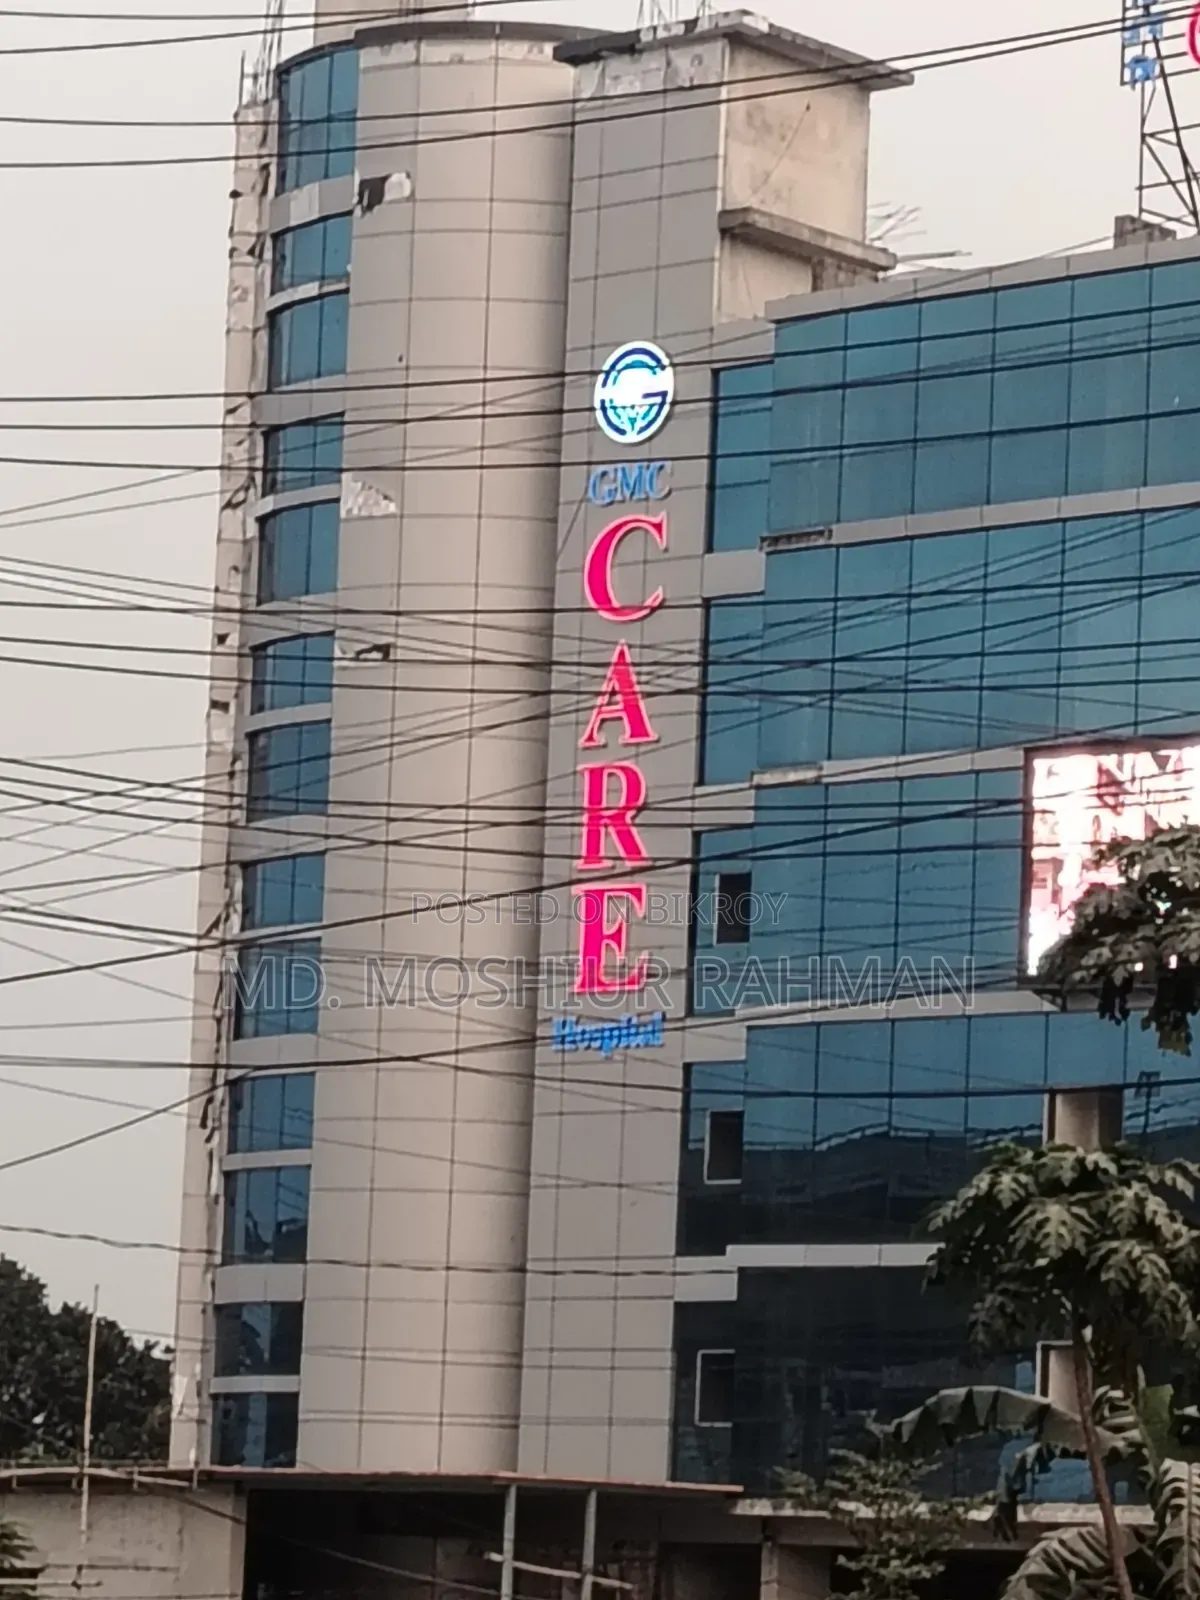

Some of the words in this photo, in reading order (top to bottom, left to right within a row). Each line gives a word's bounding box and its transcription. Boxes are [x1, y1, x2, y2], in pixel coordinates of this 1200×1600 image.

[588, 460, 672, 507] GMC
[572, 511, 668, 995] CARE
[552, 1011, 665, 1058] Hospital
